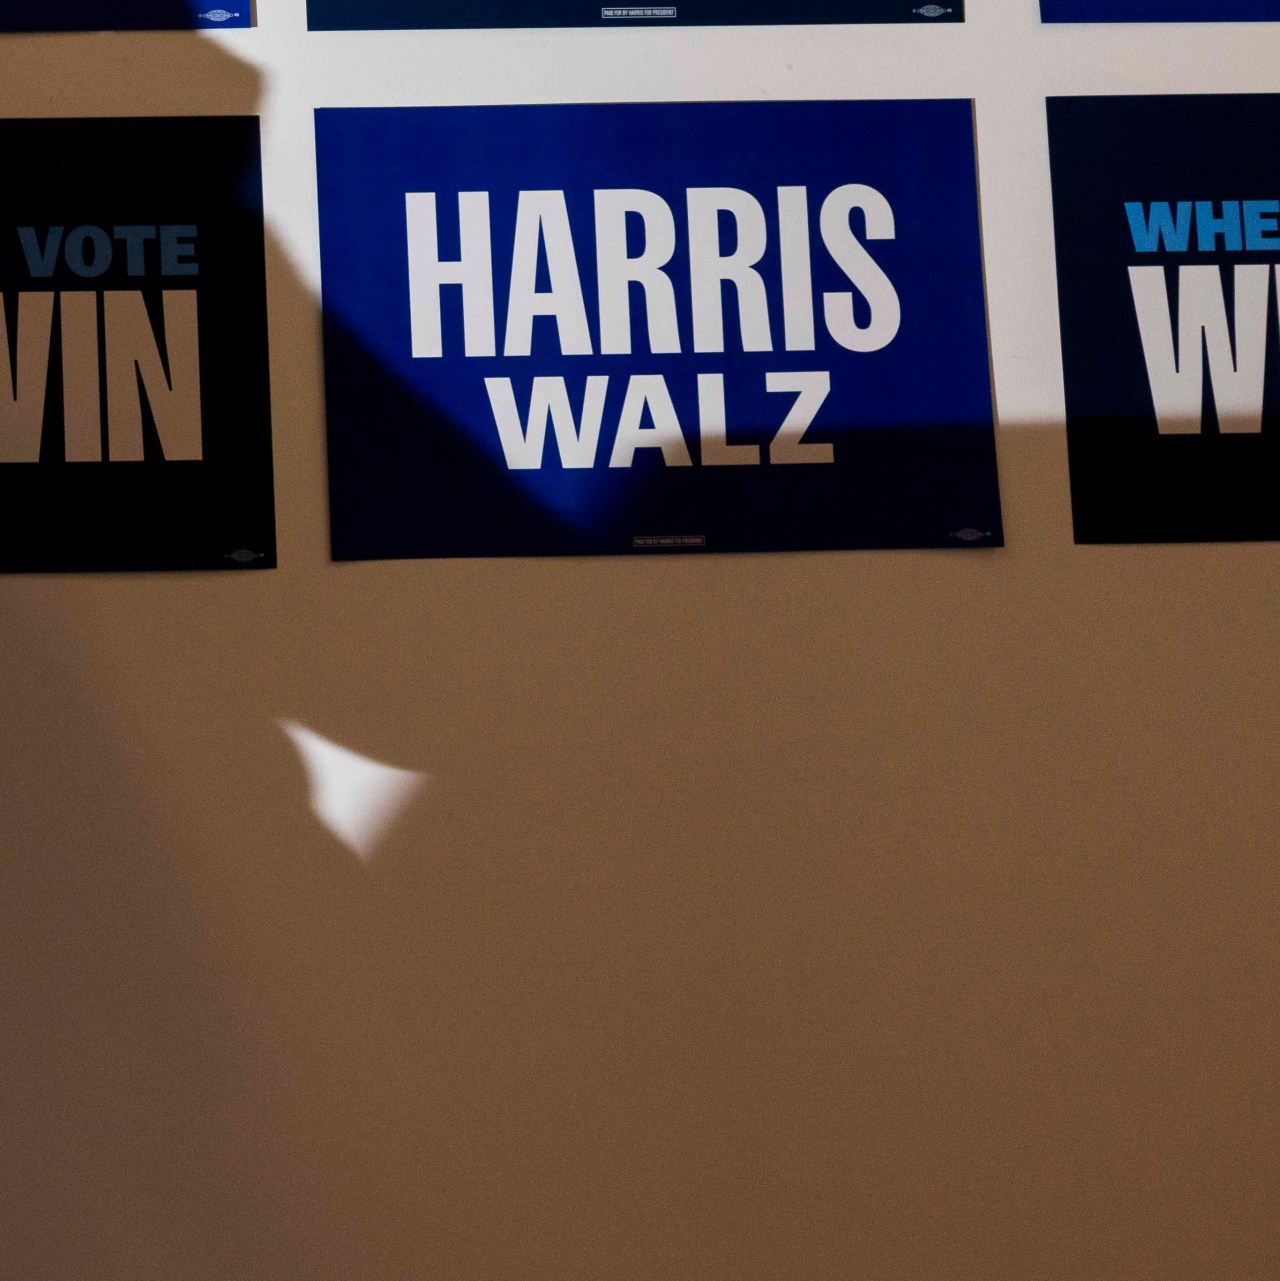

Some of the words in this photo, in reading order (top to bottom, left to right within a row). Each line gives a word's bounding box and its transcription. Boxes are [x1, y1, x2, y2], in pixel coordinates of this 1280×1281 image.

[18, 225, 199, 277] VOTE
[405, 184, 900, 358] HARRIS
[1124, 200, 1280, 252] WHE
[1128, 264, 1280, 434] W
[484, 371, 834, 469] WALZ
